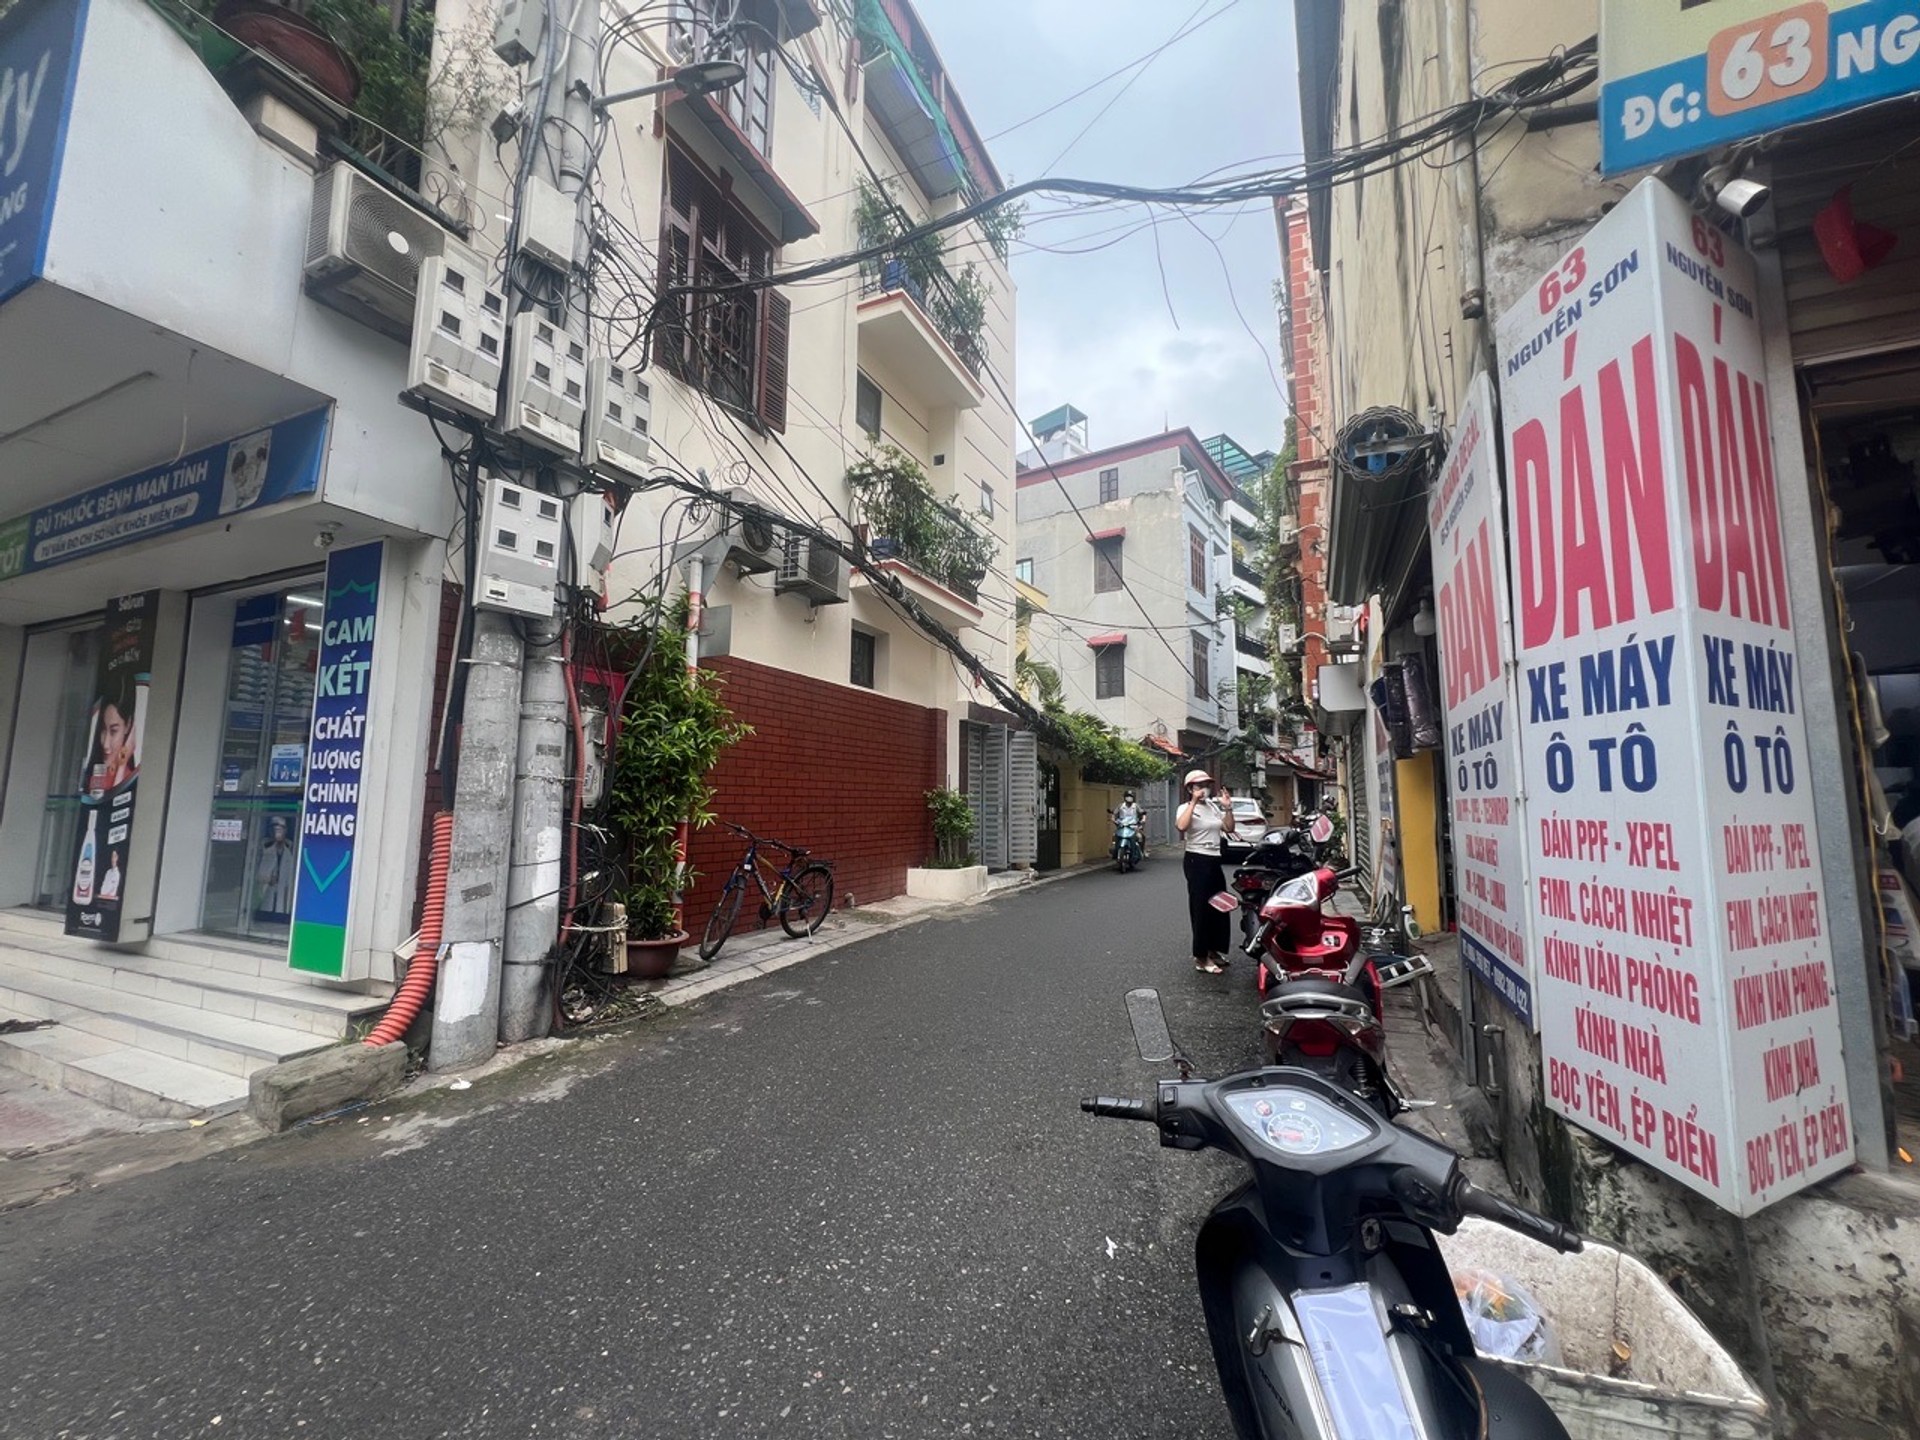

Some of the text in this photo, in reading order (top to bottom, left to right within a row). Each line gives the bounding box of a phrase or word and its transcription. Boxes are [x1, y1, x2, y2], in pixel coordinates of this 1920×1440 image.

[1621, 83, 1701, 141] ĐC:
[1720, 17, 1812, 101] 63
[1691, 214, 1725, 269] 63
[1507, 249, 1639, 378] NGUYỄN SƠN
[1538, 246, 1587, 316] 63
[97, 484, 134, 519] BỆNH
[1512, 330, 1675, 650] DÁN
[1675, 303, 1790, 631] DÁN
[324, 615, 375, 647] CAM
[1440, 516, 1501, 711] DÁN
[318, 649, 370, 698] KẾT
[1527, 633, 1676, 724] XE MÁY
[1703, 634, 1796, 715] XE MÁY
[315, 706, 366, 741] CHẤT
[1450, 700, 1504, 758] XE MÁY
[1545, 722, 1658, 793] Ô TÔ
[1723, 720, 1795, 795] Ô TÔ
[308, 778, 359, 804] CHÍNH
[311, 748, 362, 776] LƯỢNG
[1457, 751, 1499, 793] Ô TÔ
[304, 808, 355, 837] HÃNG
[1540, 811, 1573, 858] DÁN
[1576, 818, 1608, 863] PPF
[1626, 821, 1681, 872] XPEL
[1723, 814, 1751, 875] DÁN
[1751, 824, 1774, 873] PPF
[1782, 823, 1811, 871] XPEL
[1539, 876, 1577, 923] FIML
[1579, 875, 1628, 934] CÁCH
[1631, 885, 1694, 957] NHIỆT
[1726, 882, 1822, 952] FIML CÁCH NHIỆT
[1543, 930, 1582, 986] KÍNH
[1584, 940, 1623, 999] VĂN
[1626, 952, 1702, 1026] PHÒNG
[1733, 952, 1831, 1032] KÍNH VĂN PHÒNG
[1575, 1001, 1668, 1086] KÍNH NHÀ
[1762, 1027, 1822, 1104] KÍNH NHÀ
[1549, 1056, 1720, 1189] BỌC YÊN, ÉP BIỂN
[1745, 1132, 1776, 1202] BỌC
[1803, 1106, 1818, 1169] ÉP
[1257, 1362, 1296, 1426] HONDA
